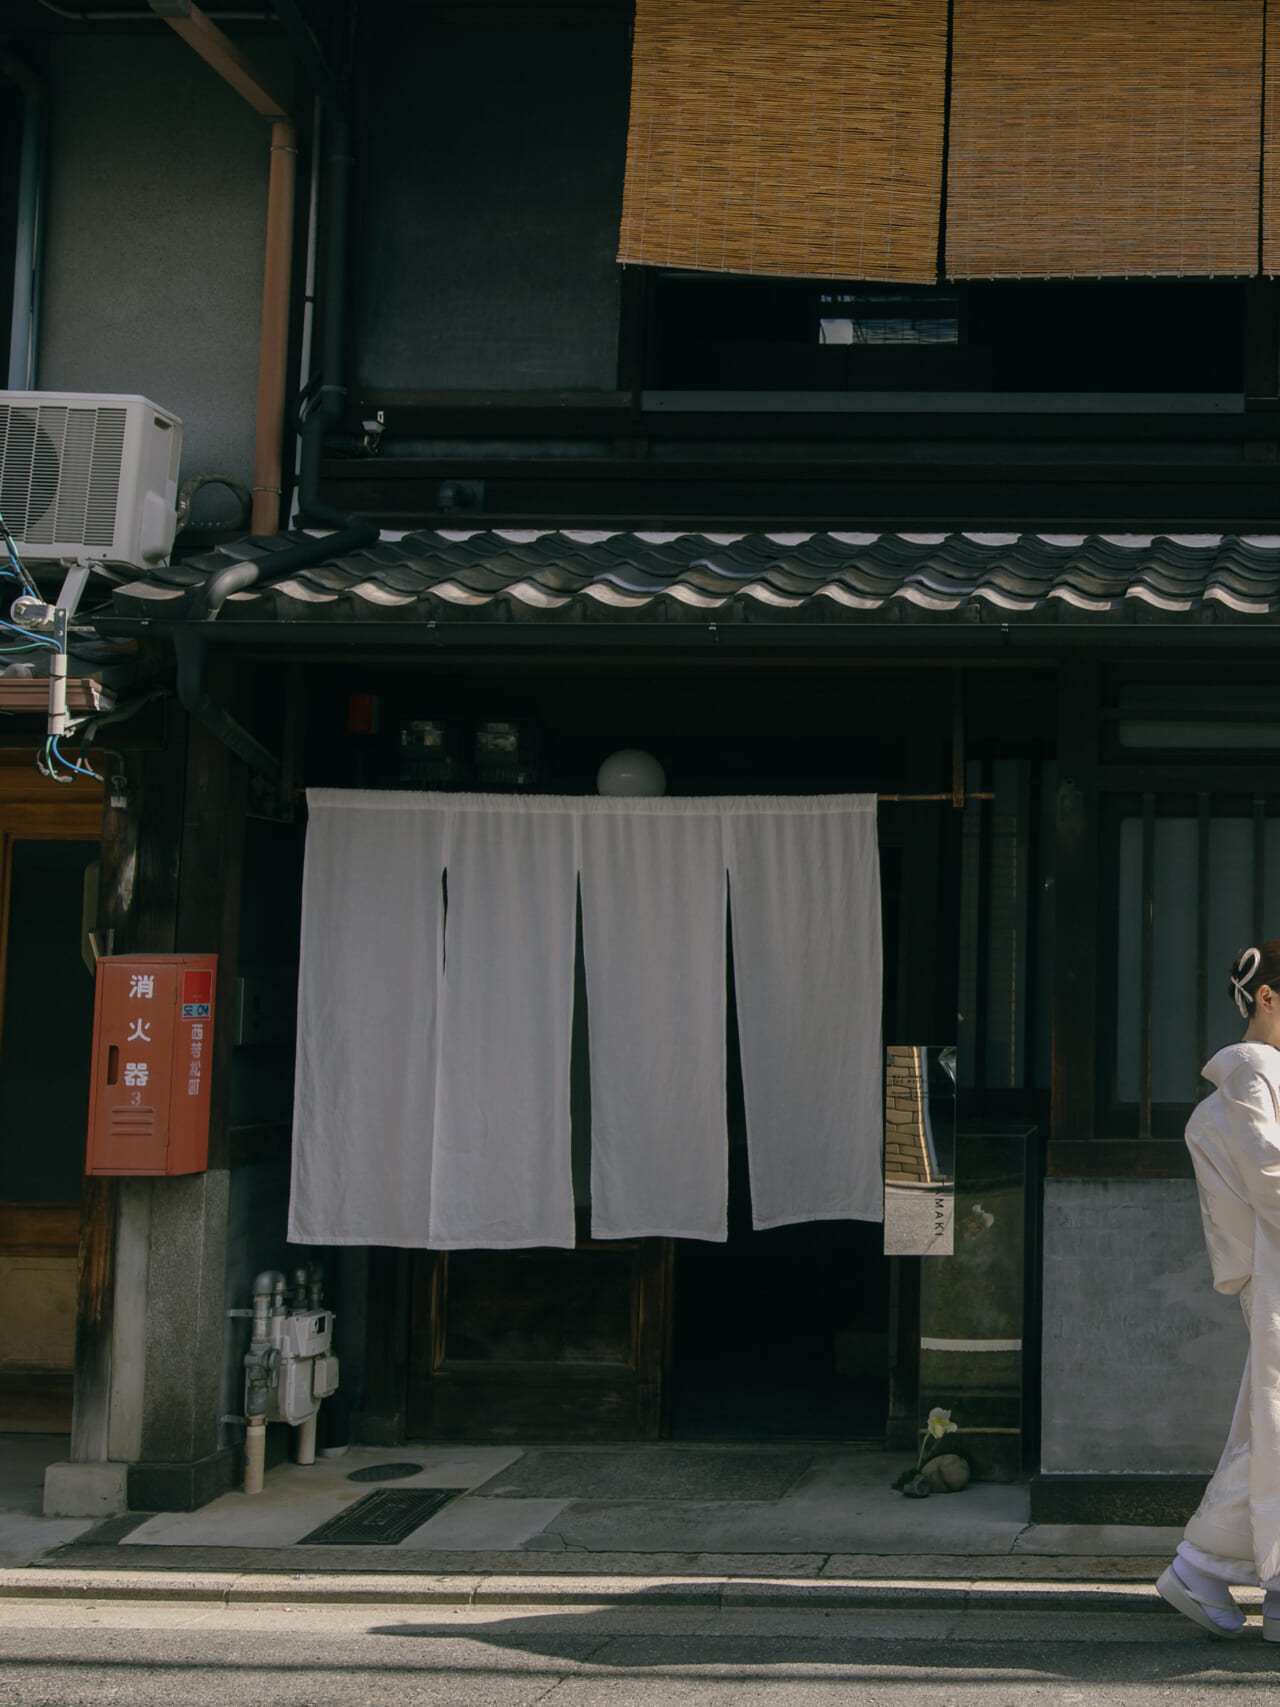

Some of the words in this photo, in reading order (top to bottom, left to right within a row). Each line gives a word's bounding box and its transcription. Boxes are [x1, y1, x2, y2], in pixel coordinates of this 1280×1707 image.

[124, 975, 154, 1087] 消火器
[183, 1005, 209, 1016] SECOM
